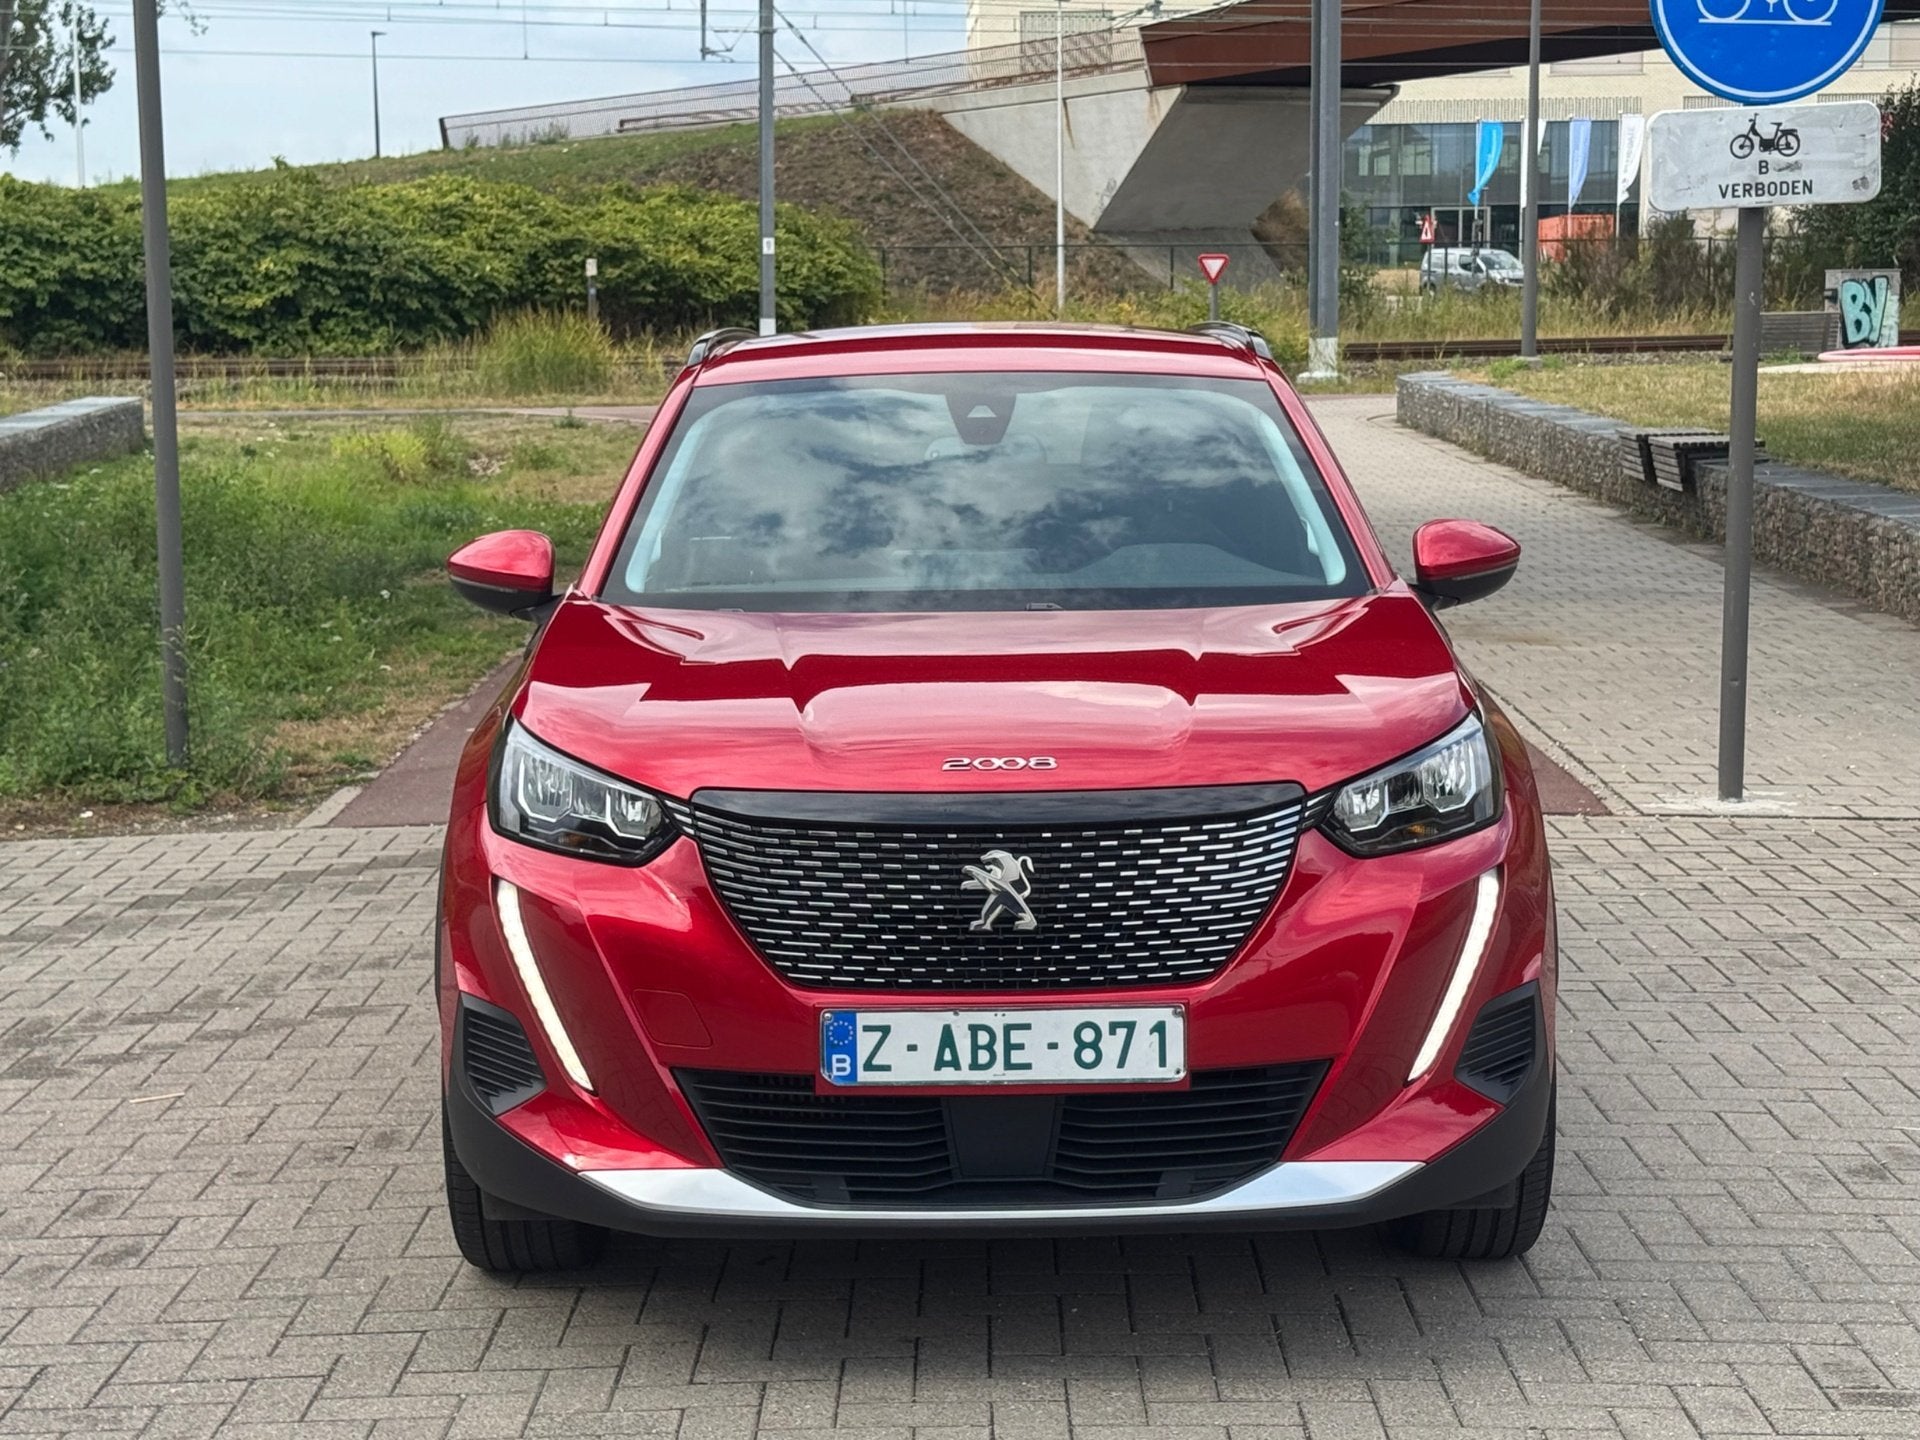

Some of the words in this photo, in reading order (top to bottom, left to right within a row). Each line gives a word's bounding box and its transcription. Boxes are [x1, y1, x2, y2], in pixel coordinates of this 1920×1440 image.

[1758, 159, 1770, 175] B
[1718, 179, 1813, 199] VERBODEN
[942, 756, 1058, 771] 2008
[831, 1054, 852, 1077] B
